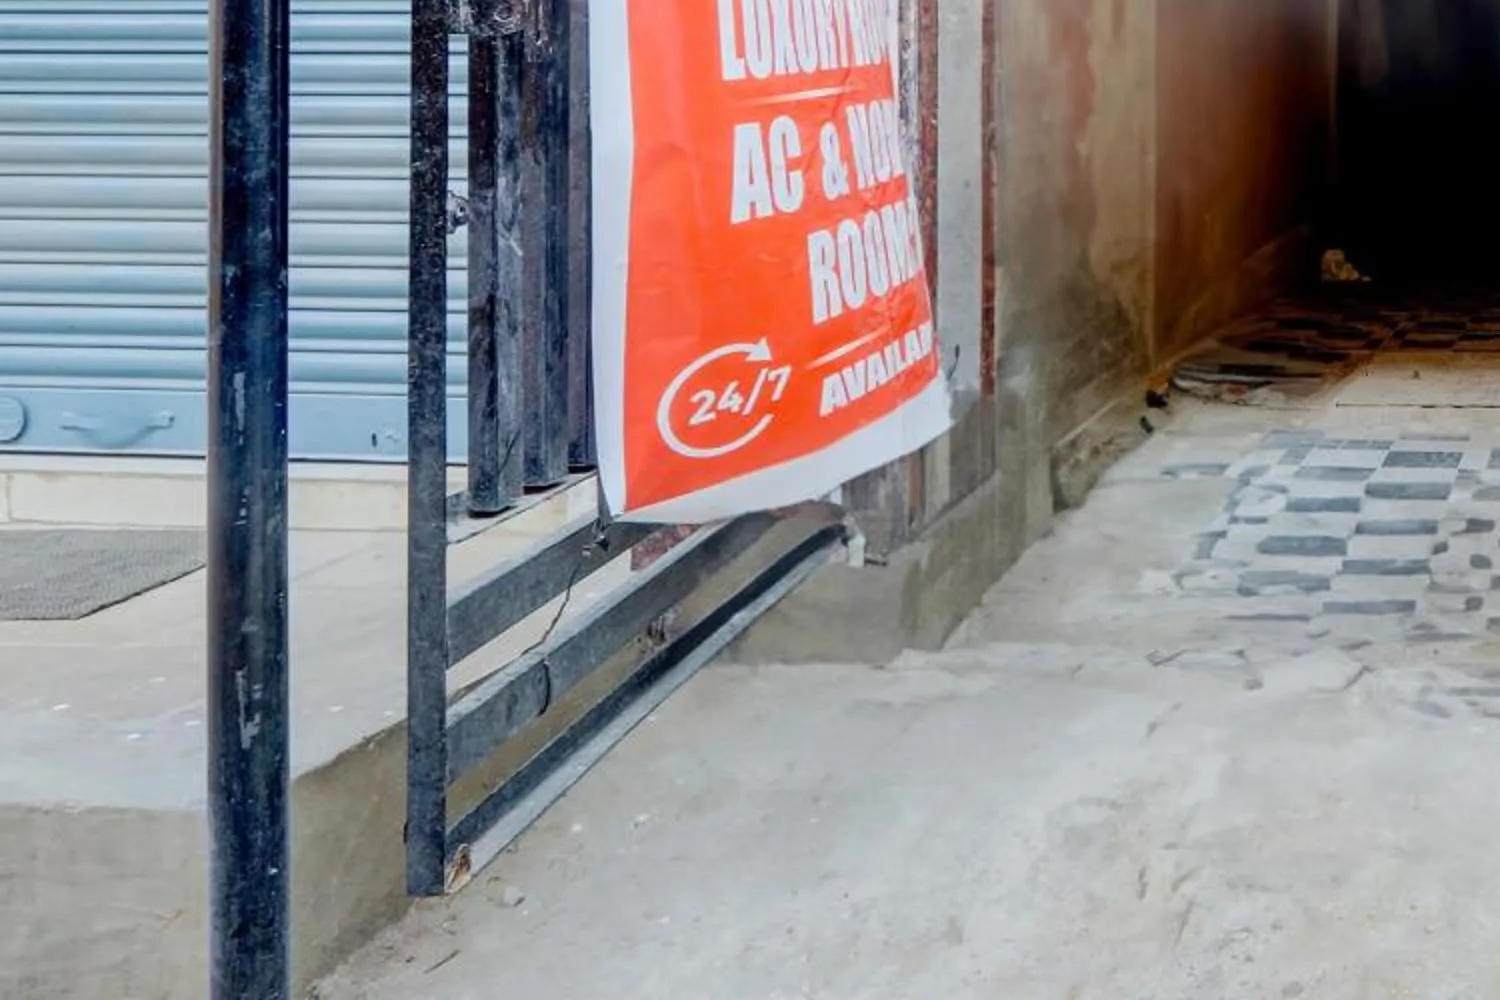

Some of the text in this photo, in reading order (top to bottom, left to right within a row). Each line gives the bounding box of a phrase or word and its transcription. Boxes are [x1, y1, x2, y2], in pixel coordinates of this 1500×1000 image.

[731, 115, 804, 224] AC
[820, 122, 850, 200] &
[688, 365, 792, 426] 24/7
